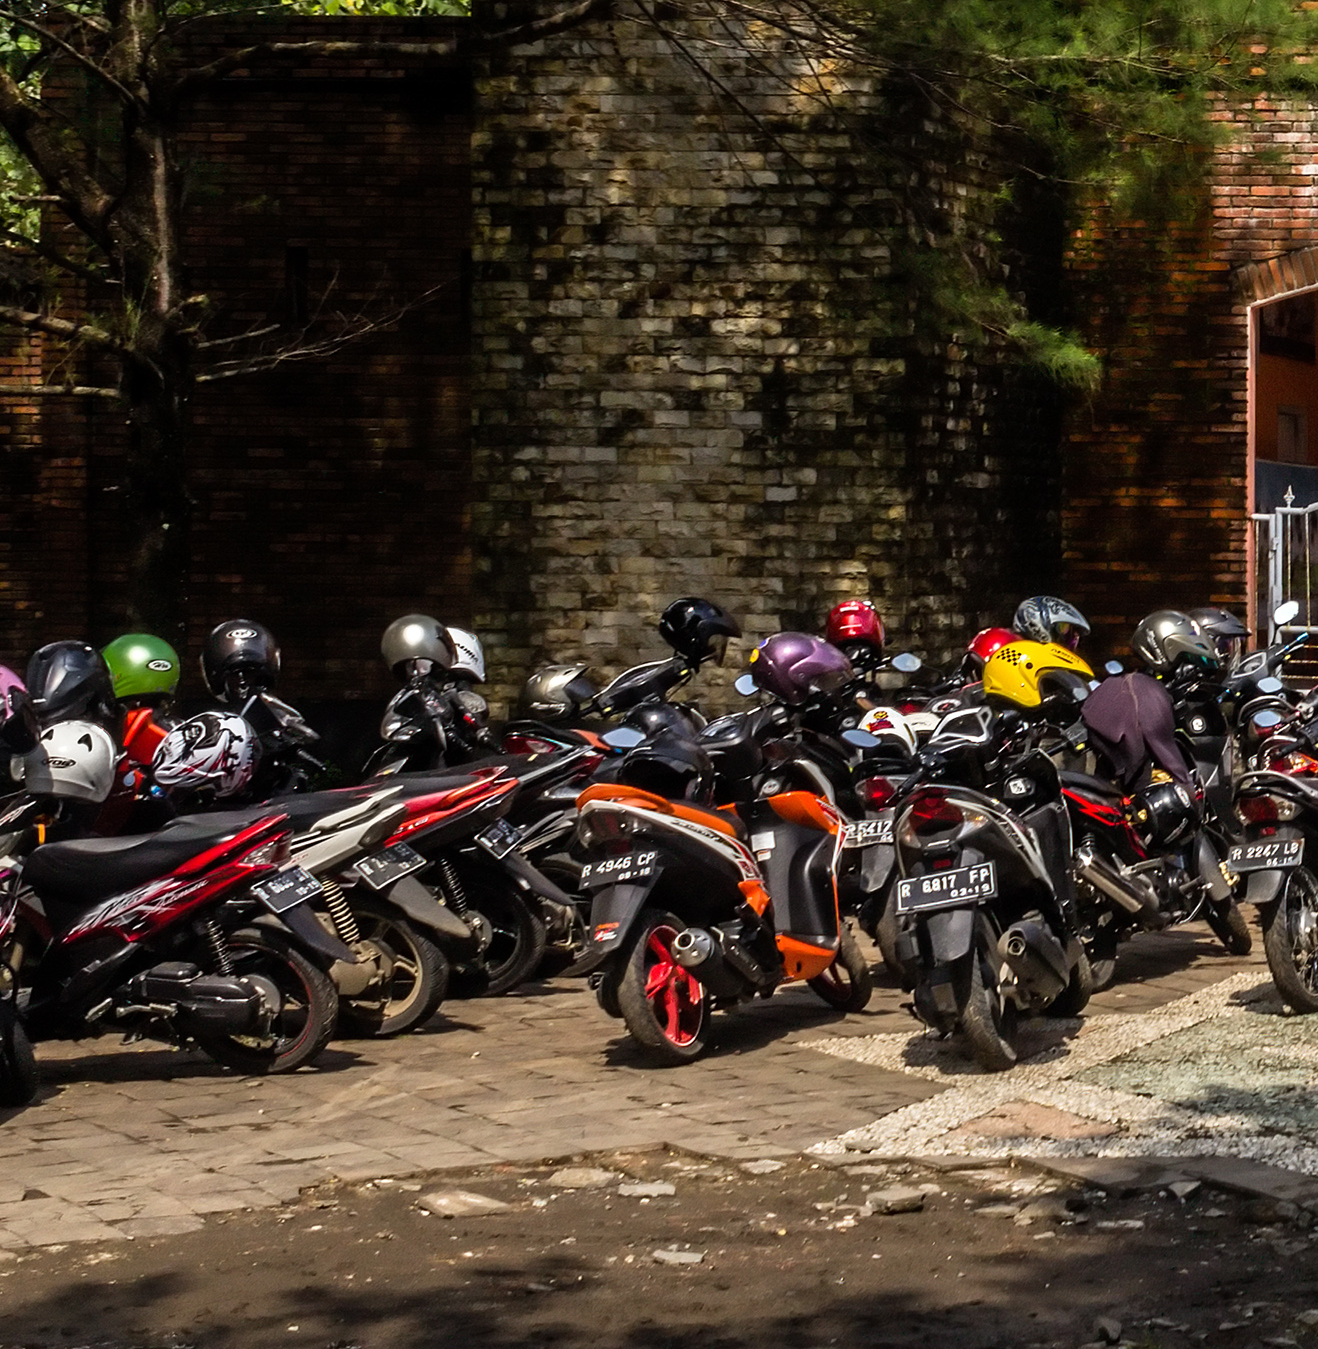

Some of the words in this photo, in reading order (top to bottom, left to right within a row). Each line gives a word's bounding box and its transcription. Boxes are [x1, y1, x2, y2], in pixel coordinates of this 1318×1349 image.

[581, 863, 593, 878] R
[595, 856, 633, 874] 4946
[636, 851, 656, 866] CP
[1231, 847, 1243, 861] R
[1283, 841, 1300, 855] LB
[901, 883, 912, 898] R
[968, 867, 990, 884] FP
